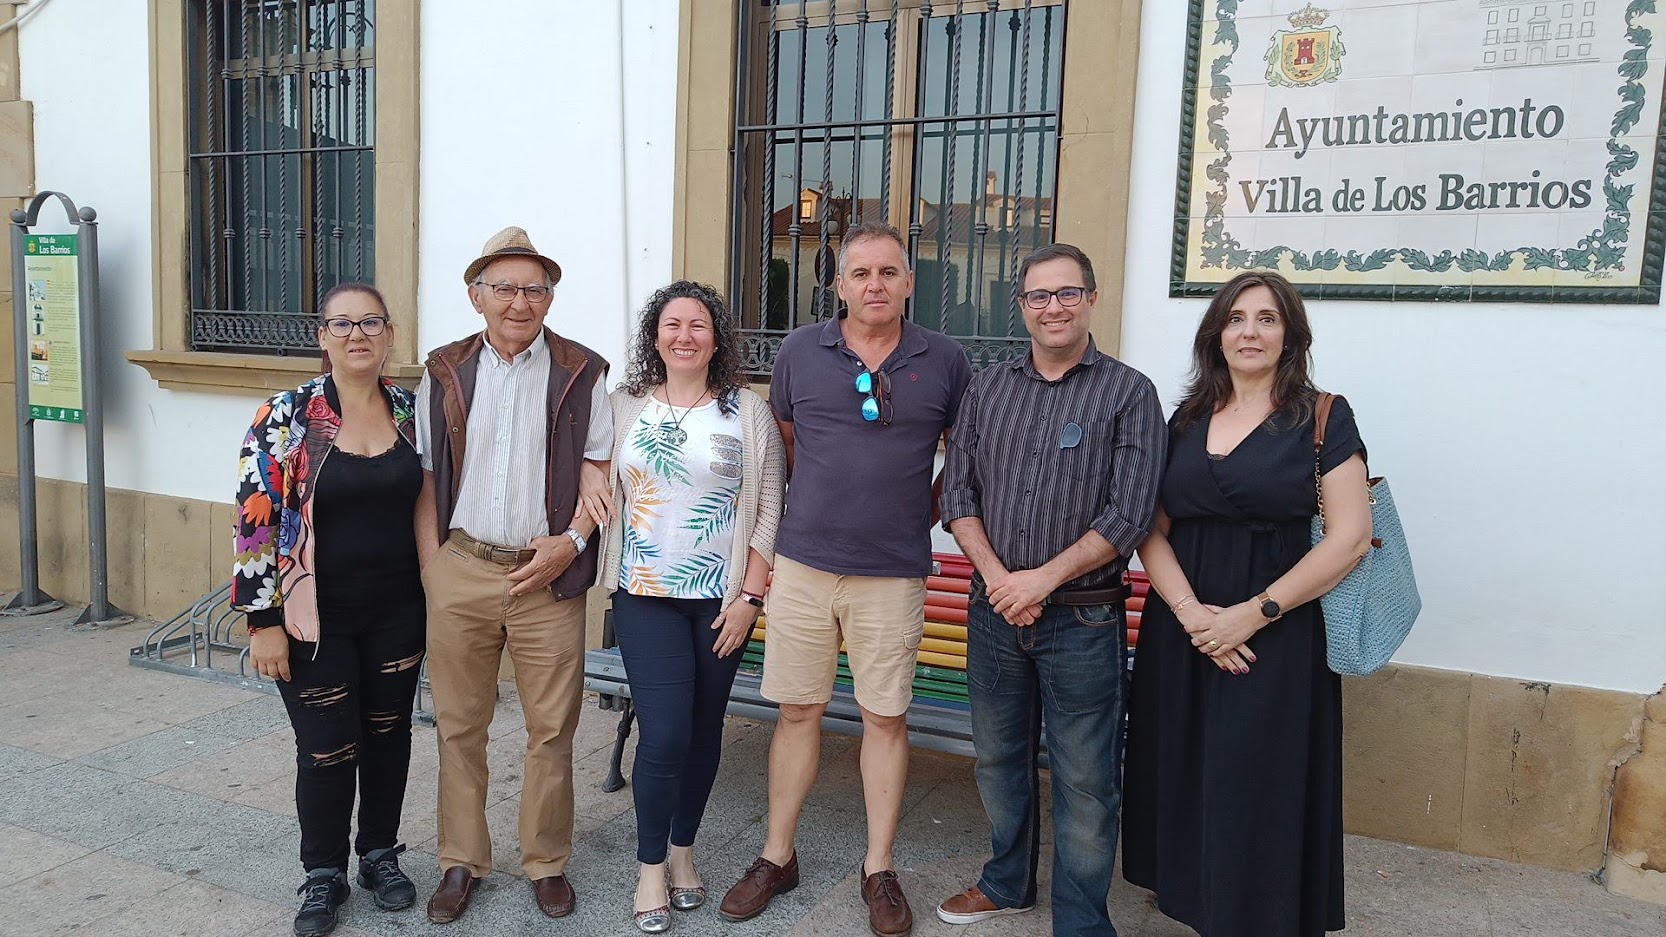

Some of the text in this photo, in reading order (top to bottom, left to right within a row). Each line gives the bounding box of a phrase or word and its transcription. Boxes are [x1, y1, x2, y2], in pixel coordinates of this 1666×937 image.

[1265, 98, 1564, 159] Ayuntamiento
[1239, 170, 1592, 214] Villa de Los Barrios
[39, 245, 71, 254] Los Barrios
[49, 236, 56, 244] de
